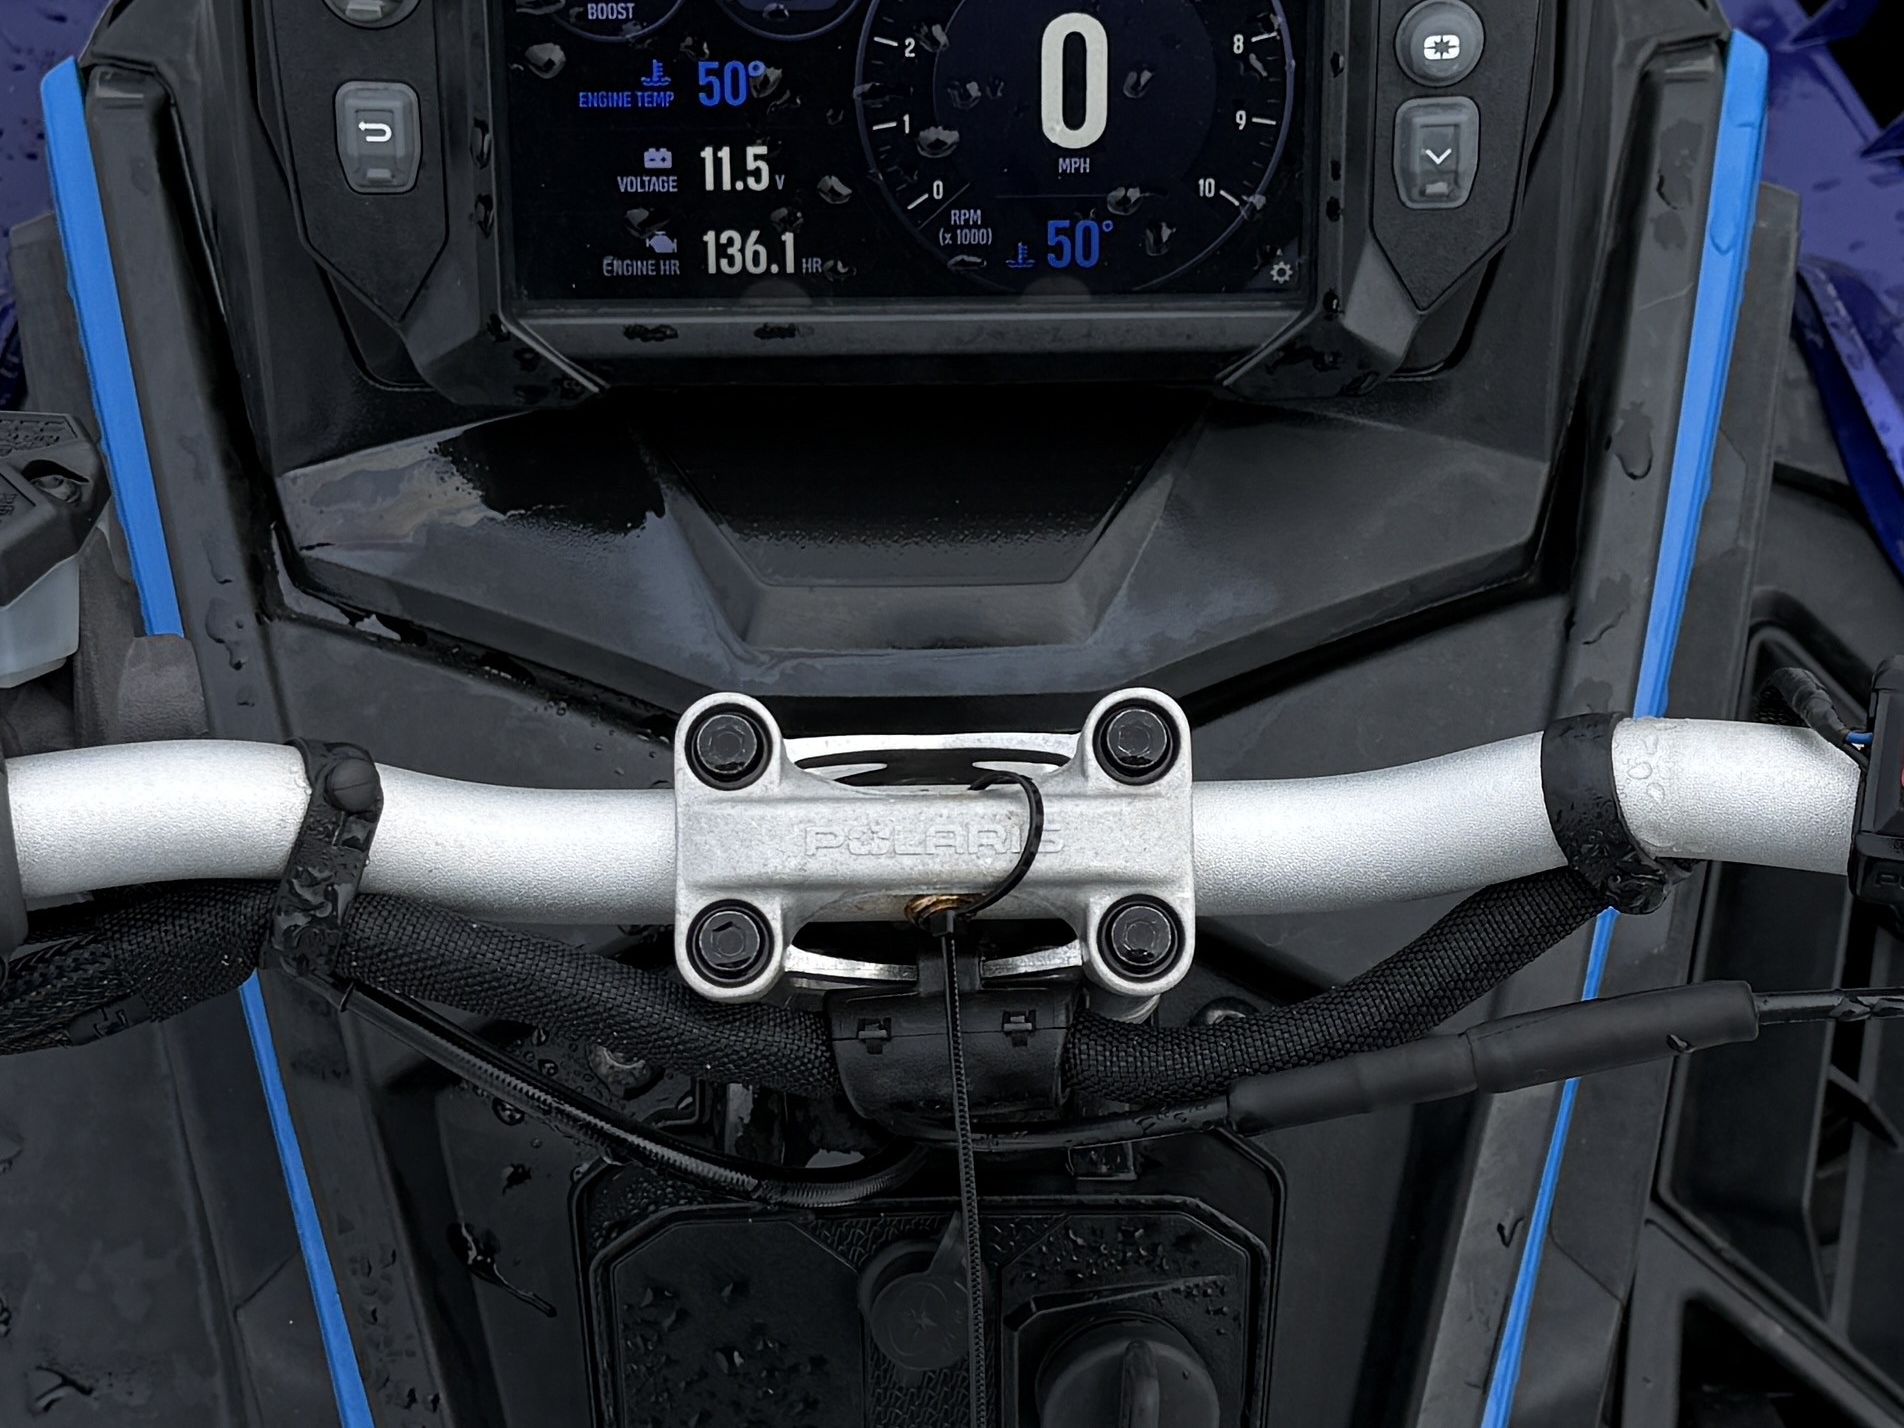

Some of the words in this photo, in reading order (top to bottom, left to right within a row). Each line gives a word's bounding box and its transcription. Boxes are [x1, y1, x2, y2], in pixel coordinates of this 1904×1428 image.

[587, 3, 635, 20] BOOST
[904, 40, 916, 57] 2
[1233, 34, 1243, 53] 8
[698, 60, 765, 107] 50°
[1041, 12, 1108, 149] 0
[579, 92, 631, 108] ENGINE
[635, 92, 674, 108] TEMP
[902, 115, 910, 133] 1
[1236, 110, 1246, 129] 9
[700, 146, 769, 191] 11.5
[776, 175, 785, 190] V
[1058, 158, 1090, 173] MPH
[617, 177, 678, 192] VOLTAGE
[933, 181, 943, 199] 0
[1198, 179, 1215, 197] 10
[951, 210, 982, 225] RPM
[957, 229, 992, 246] 1000)
[1047, 219, 1114, 268] 50°
[703, 230, 794, 274] 136.1
[802, 258, 821, 273] HR
[603, 259, 655, 276] ENGINE
[660, 260, 680, 275] HR
